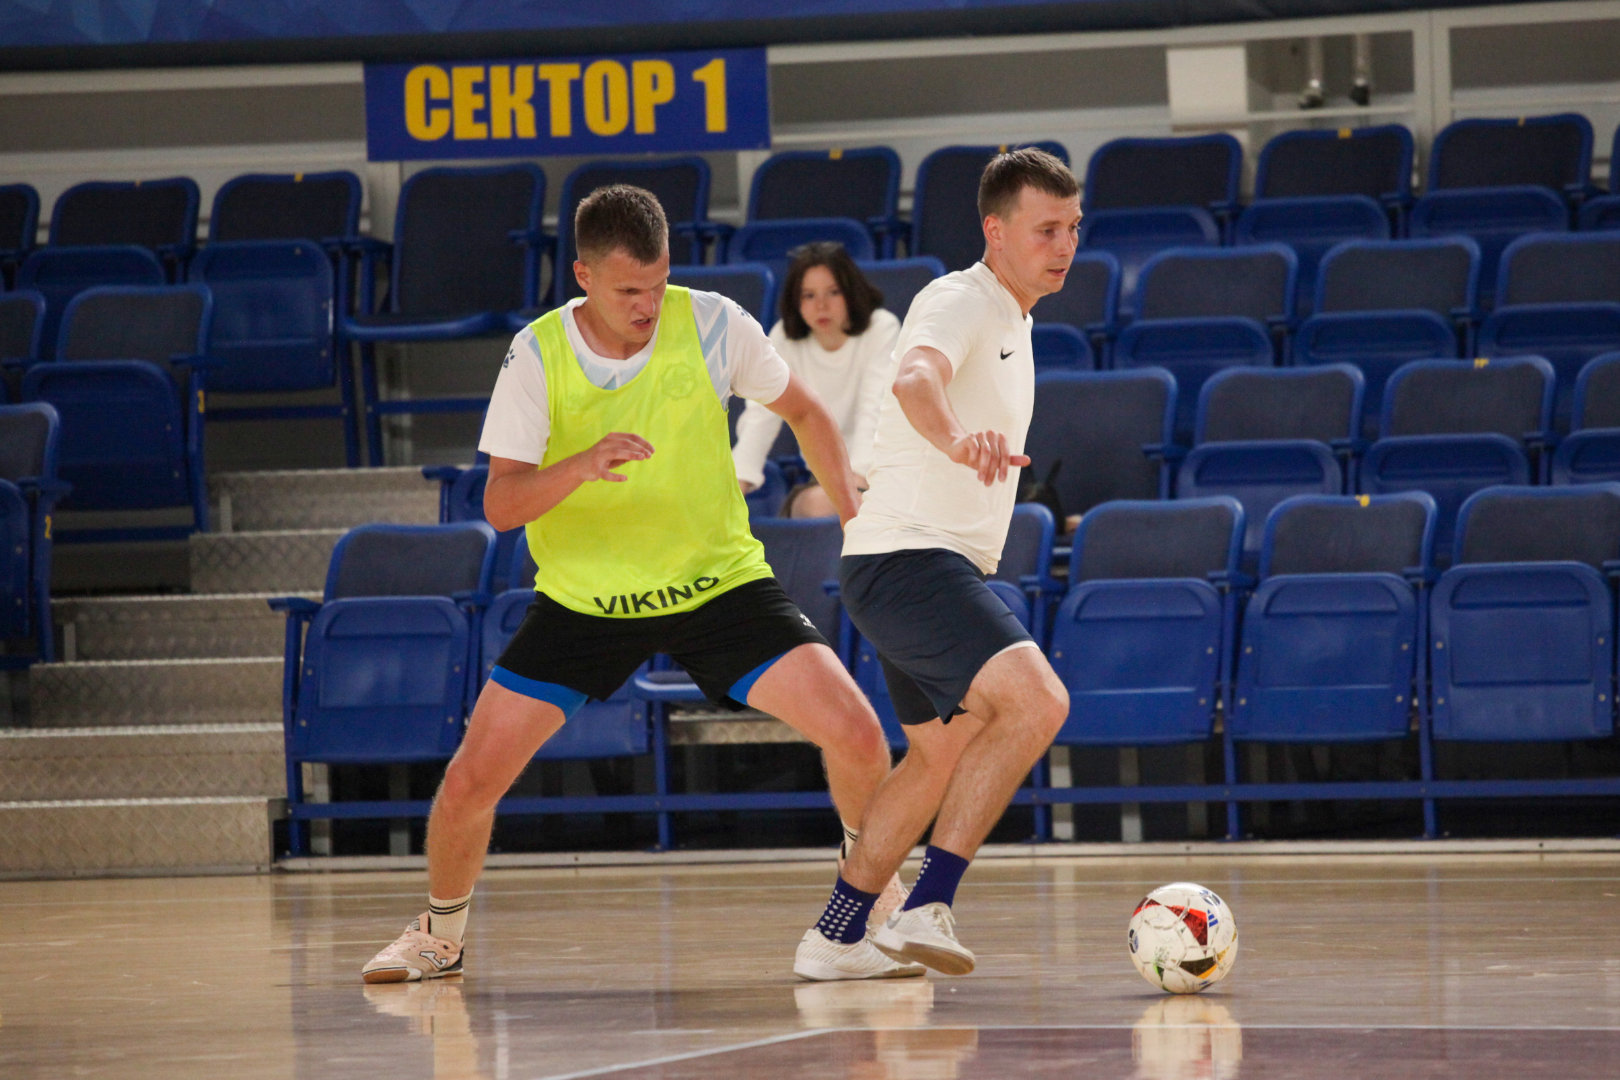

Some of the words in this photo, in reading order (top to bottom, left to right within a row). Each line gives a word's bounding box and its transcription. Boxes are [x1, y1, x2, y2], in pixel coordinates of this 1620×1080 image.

[405, 60, 676, 141] СЕКТОР
[692, 58, 727, 133] 1
[594, 576, 720, 615] VIKING
